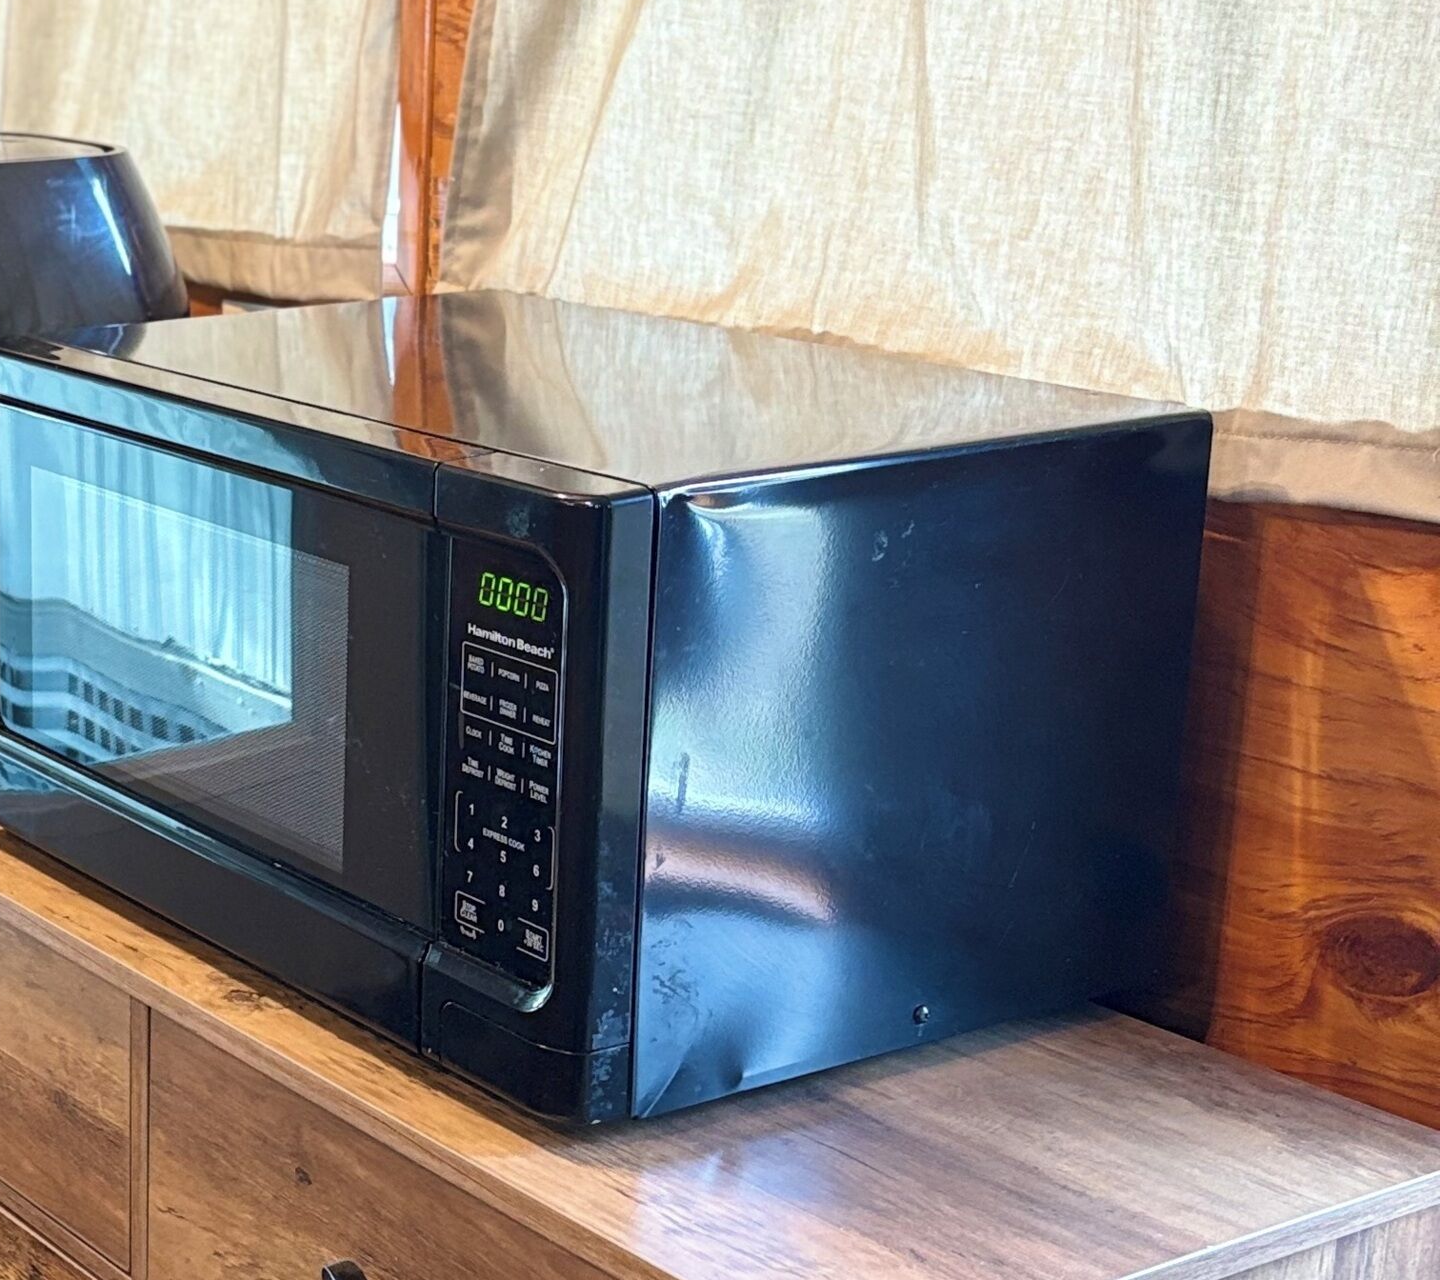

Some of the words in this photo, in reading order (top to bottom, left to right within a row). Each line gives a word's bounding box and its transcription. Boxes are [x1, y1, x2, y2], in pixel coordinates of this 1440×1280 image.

[467, 622, 516, 648] Hamilton
[516, 638, 552, 660] Beach
[498, 668, 520, 682] POPCORN
[528, 780, 549, 795] POWER
[529, 789, 547, 803] LEVEL
[469, 803, 474, 815] 1
[501, 816, 508, 829] 2
[482, 827, 507, 845] EXPRESS
[508, 837, 525, 852] COOK
[534, 829, 541, 842] 3
[467, 838, 474, 850] 4
[500, 851, 507, 863] 5
[467, 871, 474, 883] 7
[533, 865, 540, 877] 6
[499, 885, 506, 898] 8
[532, 899, 539, 912] 9
[498, 920, 505, 932] 0
